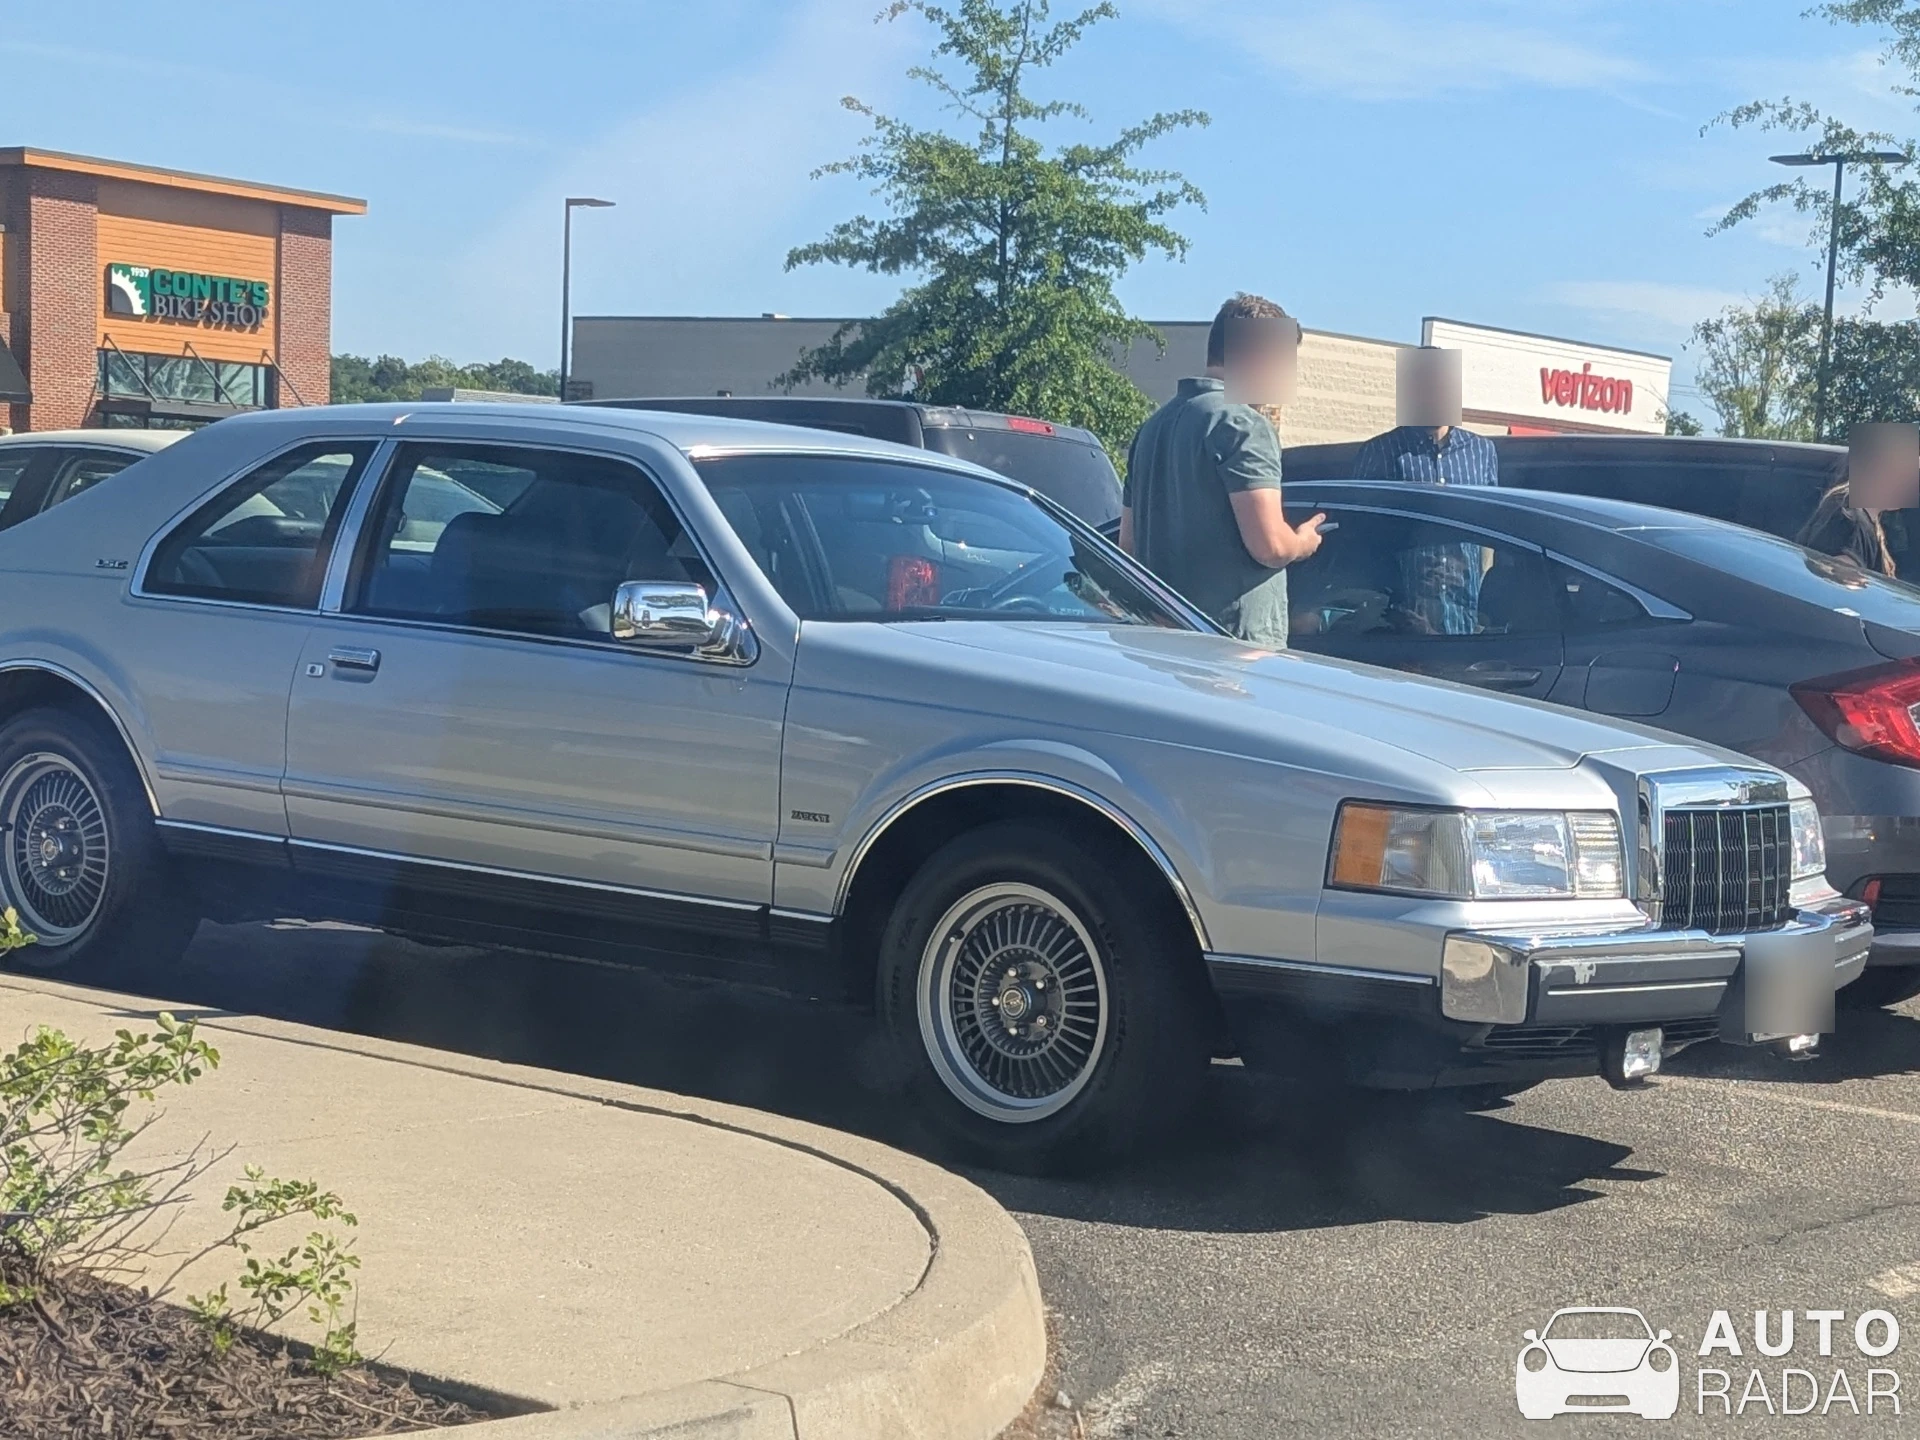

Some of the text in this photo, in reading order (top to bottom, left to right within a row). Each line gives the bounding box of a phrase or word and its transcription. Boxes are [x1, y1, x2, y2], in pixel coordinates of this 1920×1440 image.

[130, 267, 149, 278] 1957
[153, 269, 269, 307] CONTE'S
[154, 294, 269, 327] BIKE SHOP
[1540, 362, 1633, 415] verizon
